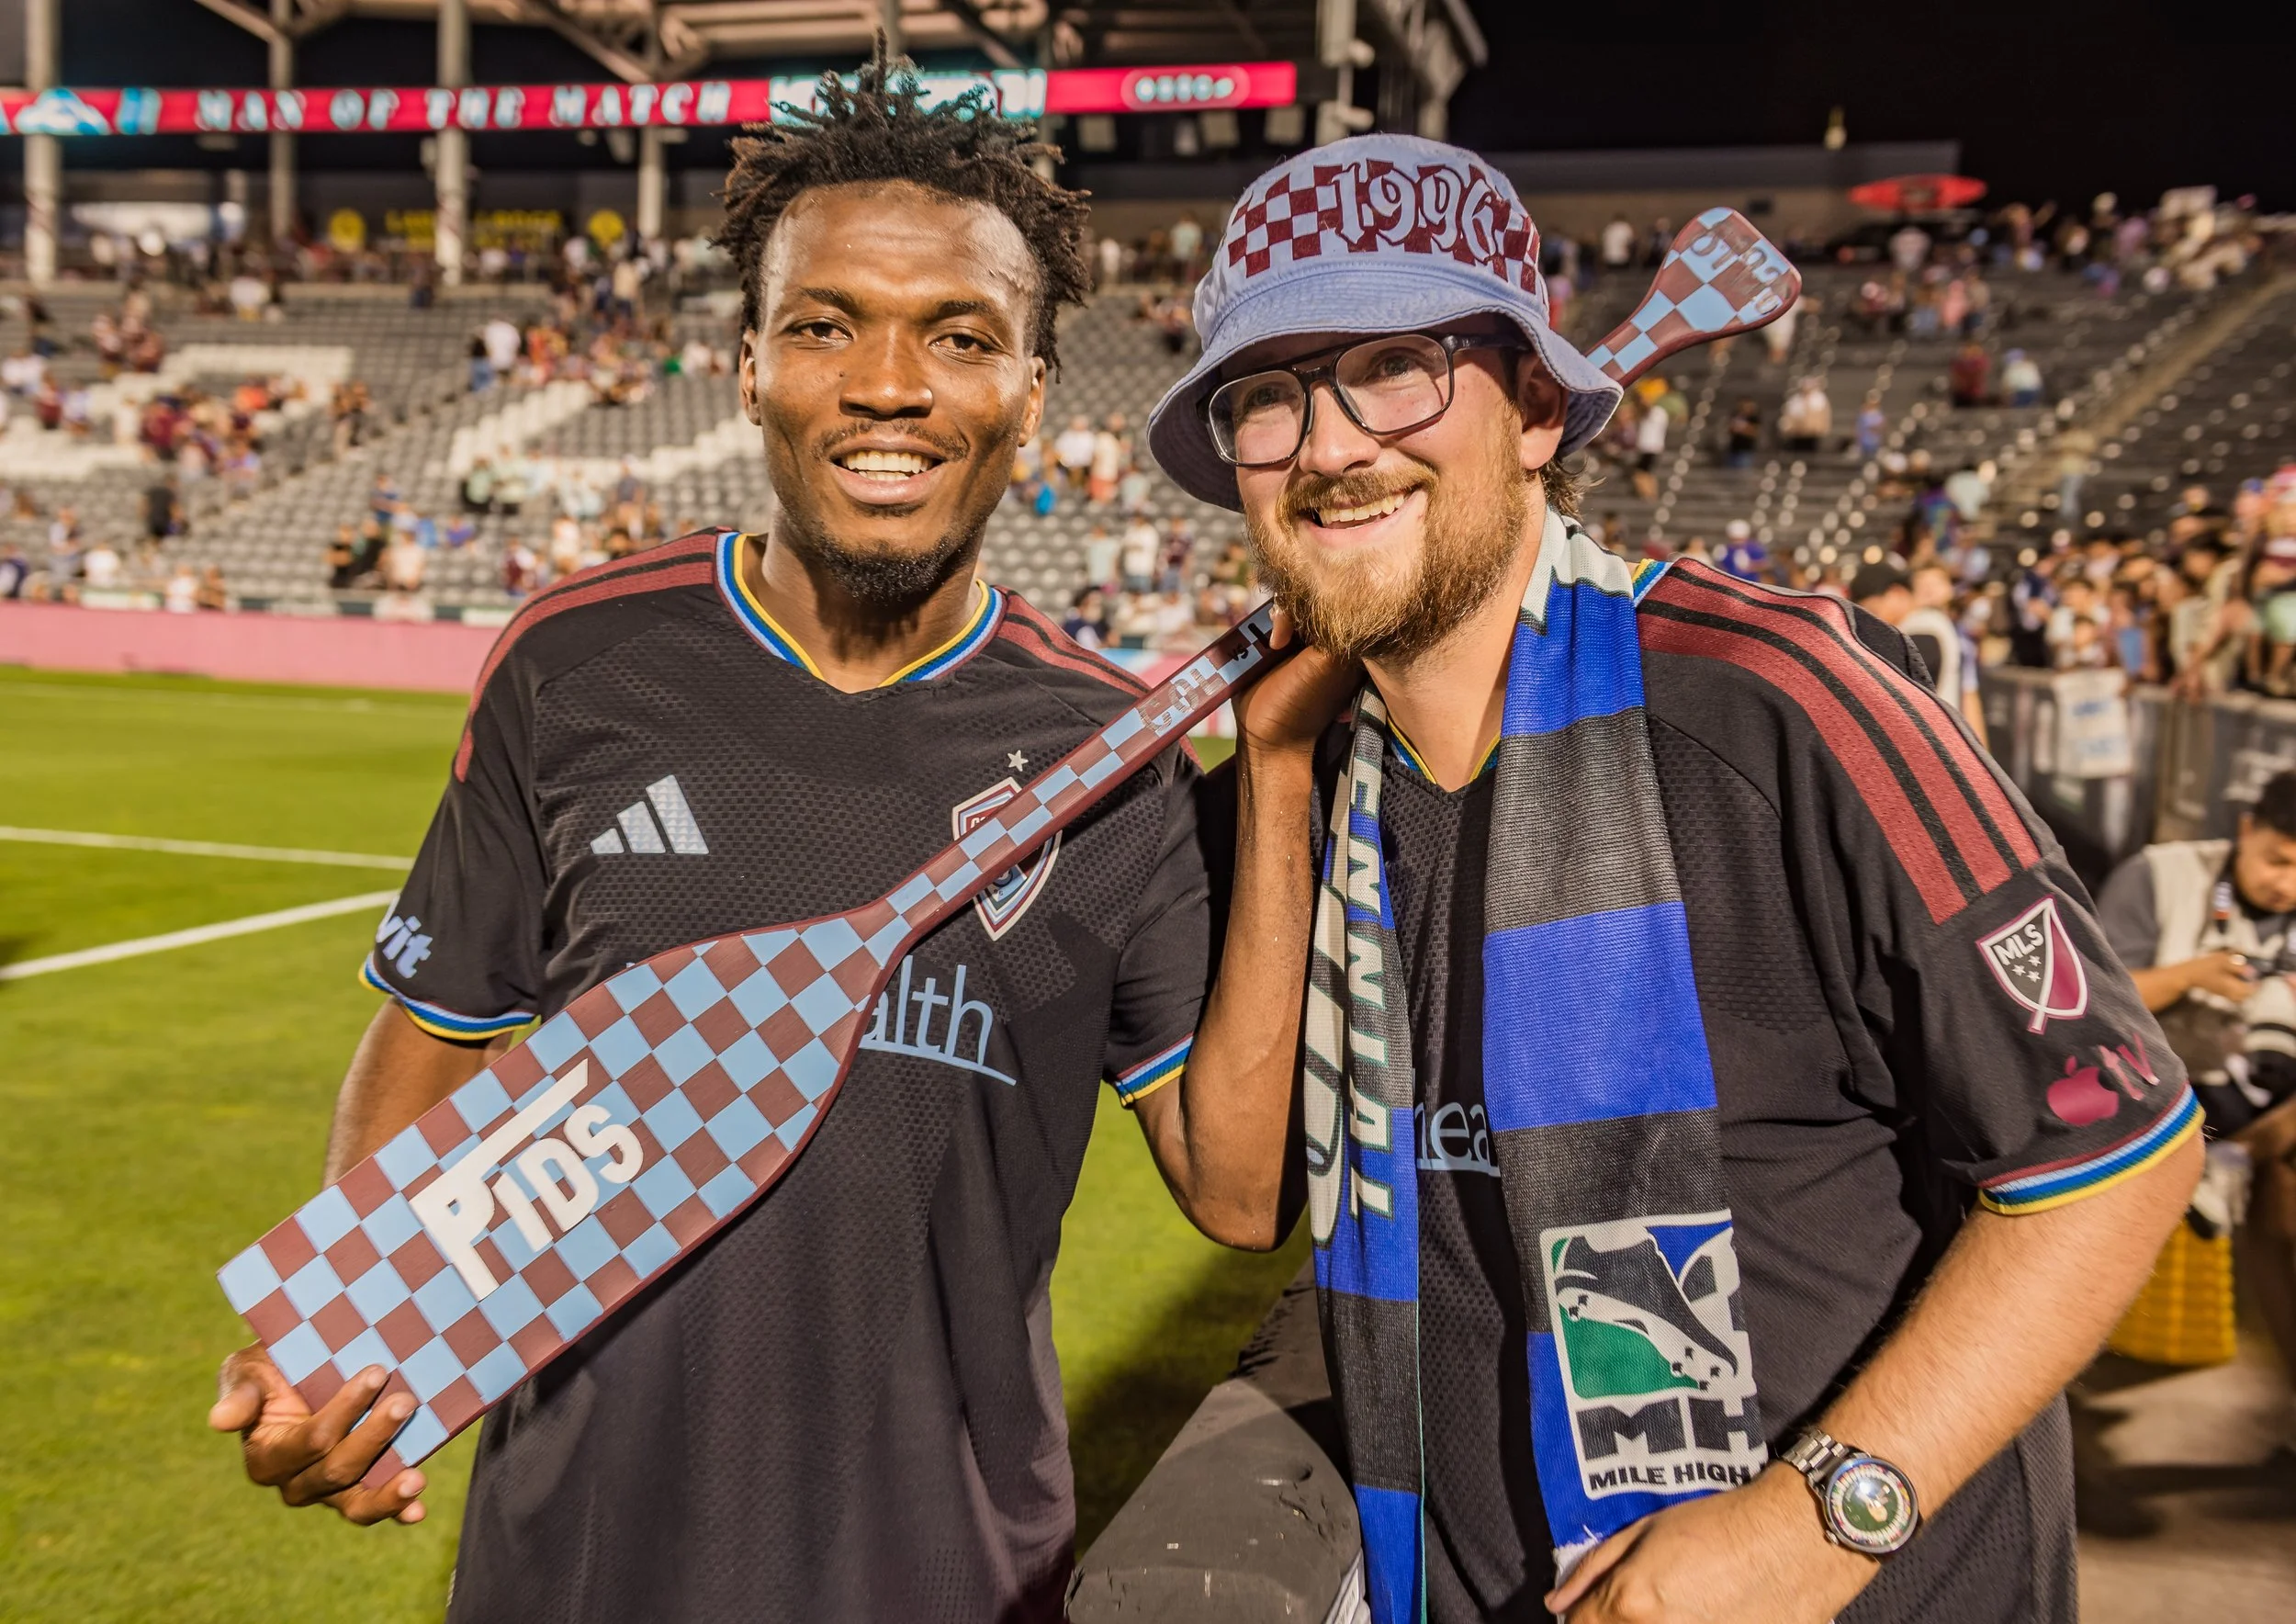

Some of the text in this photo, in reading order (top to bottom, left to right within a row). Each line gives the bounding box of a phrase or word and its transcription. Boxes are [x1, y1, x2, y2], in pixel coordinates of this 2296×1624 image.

[194, 88, 307, 130] MAN
[329, 88, 400, 130] OF
[423, 85, 526, 130] THE
[548, 81, 732, 127] MATCH
[1331, 161, 1497, 265] 1996
[1993, 923, 2044, 966] MLS
[1588, 1465, 1668, 1492] MILE
[1672, 1460, 1752, 1486] HIGH
